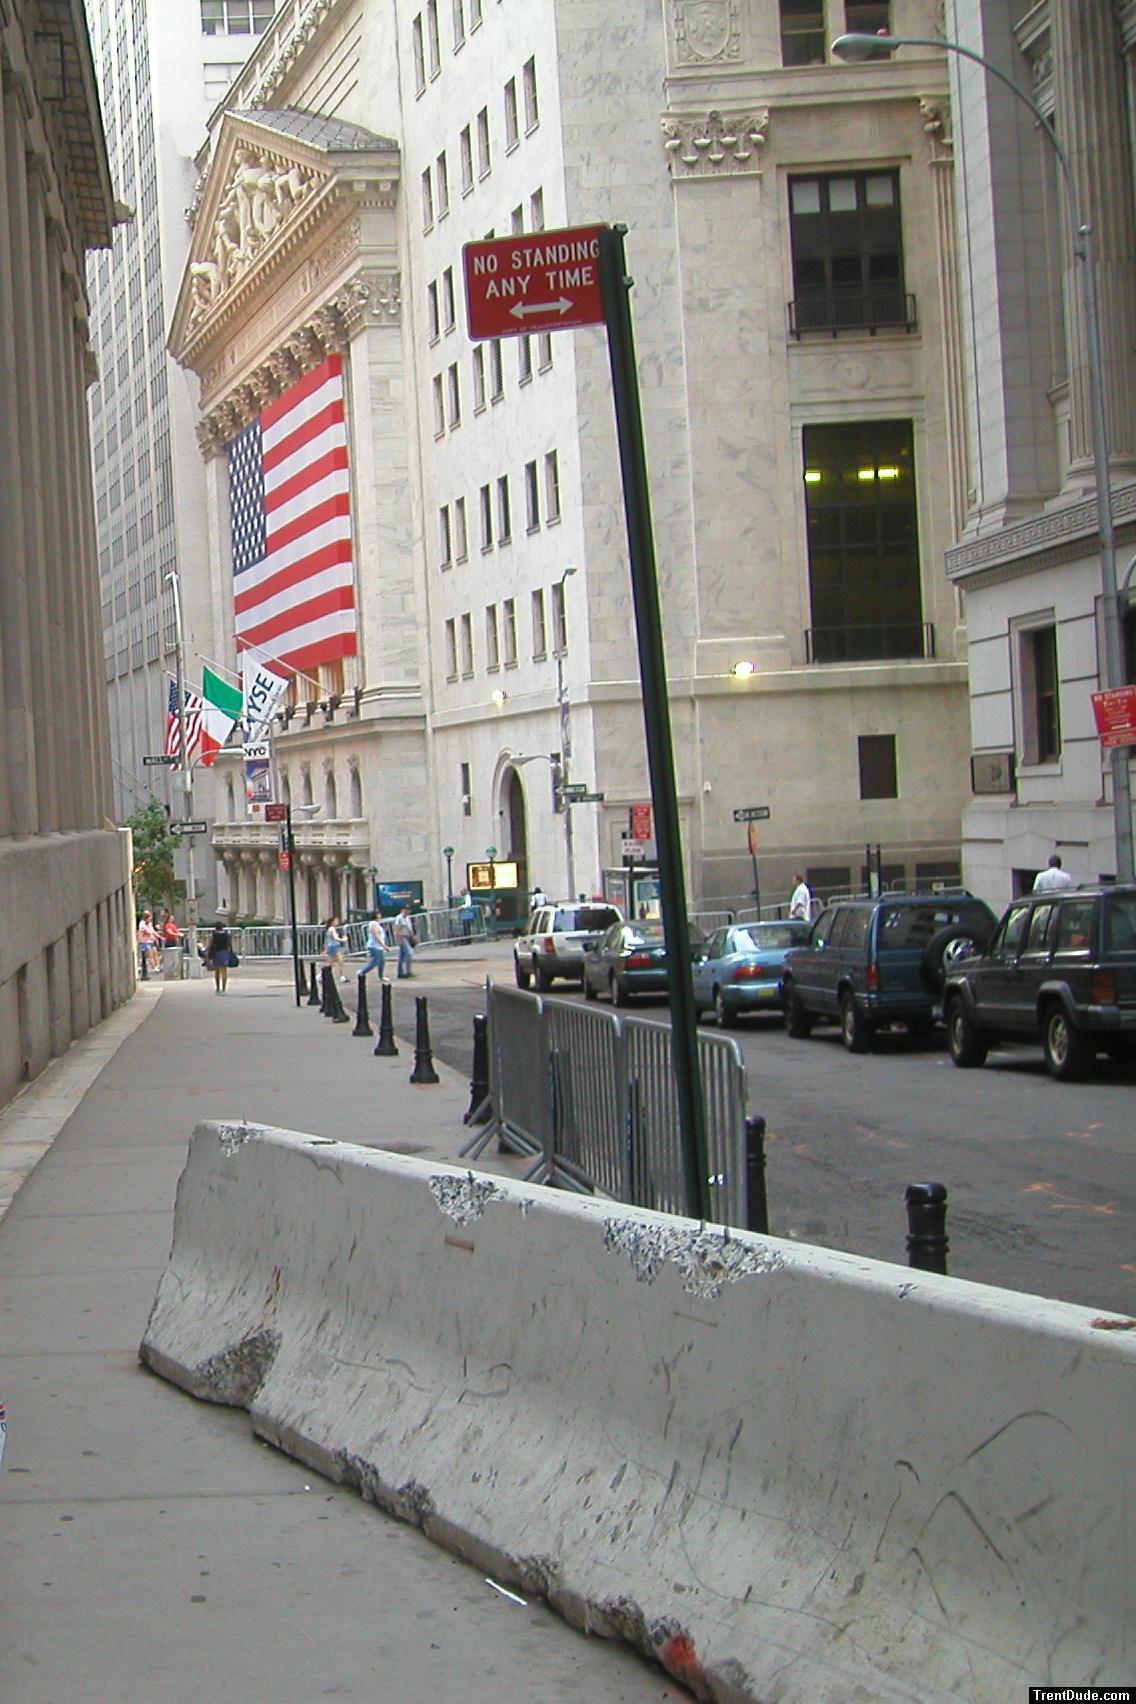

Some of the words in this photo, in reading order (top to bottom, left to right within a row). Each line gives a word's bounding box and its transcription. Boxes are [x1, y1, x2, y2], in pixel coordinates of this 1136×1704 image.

[474, 254, 498, 275] NO
[512, 239, 600, 269] STANDING
[486, 274, 531, 299] ANY
[546, 266, 594, 291] TIME
[244, 746, 267, 757] NYC
